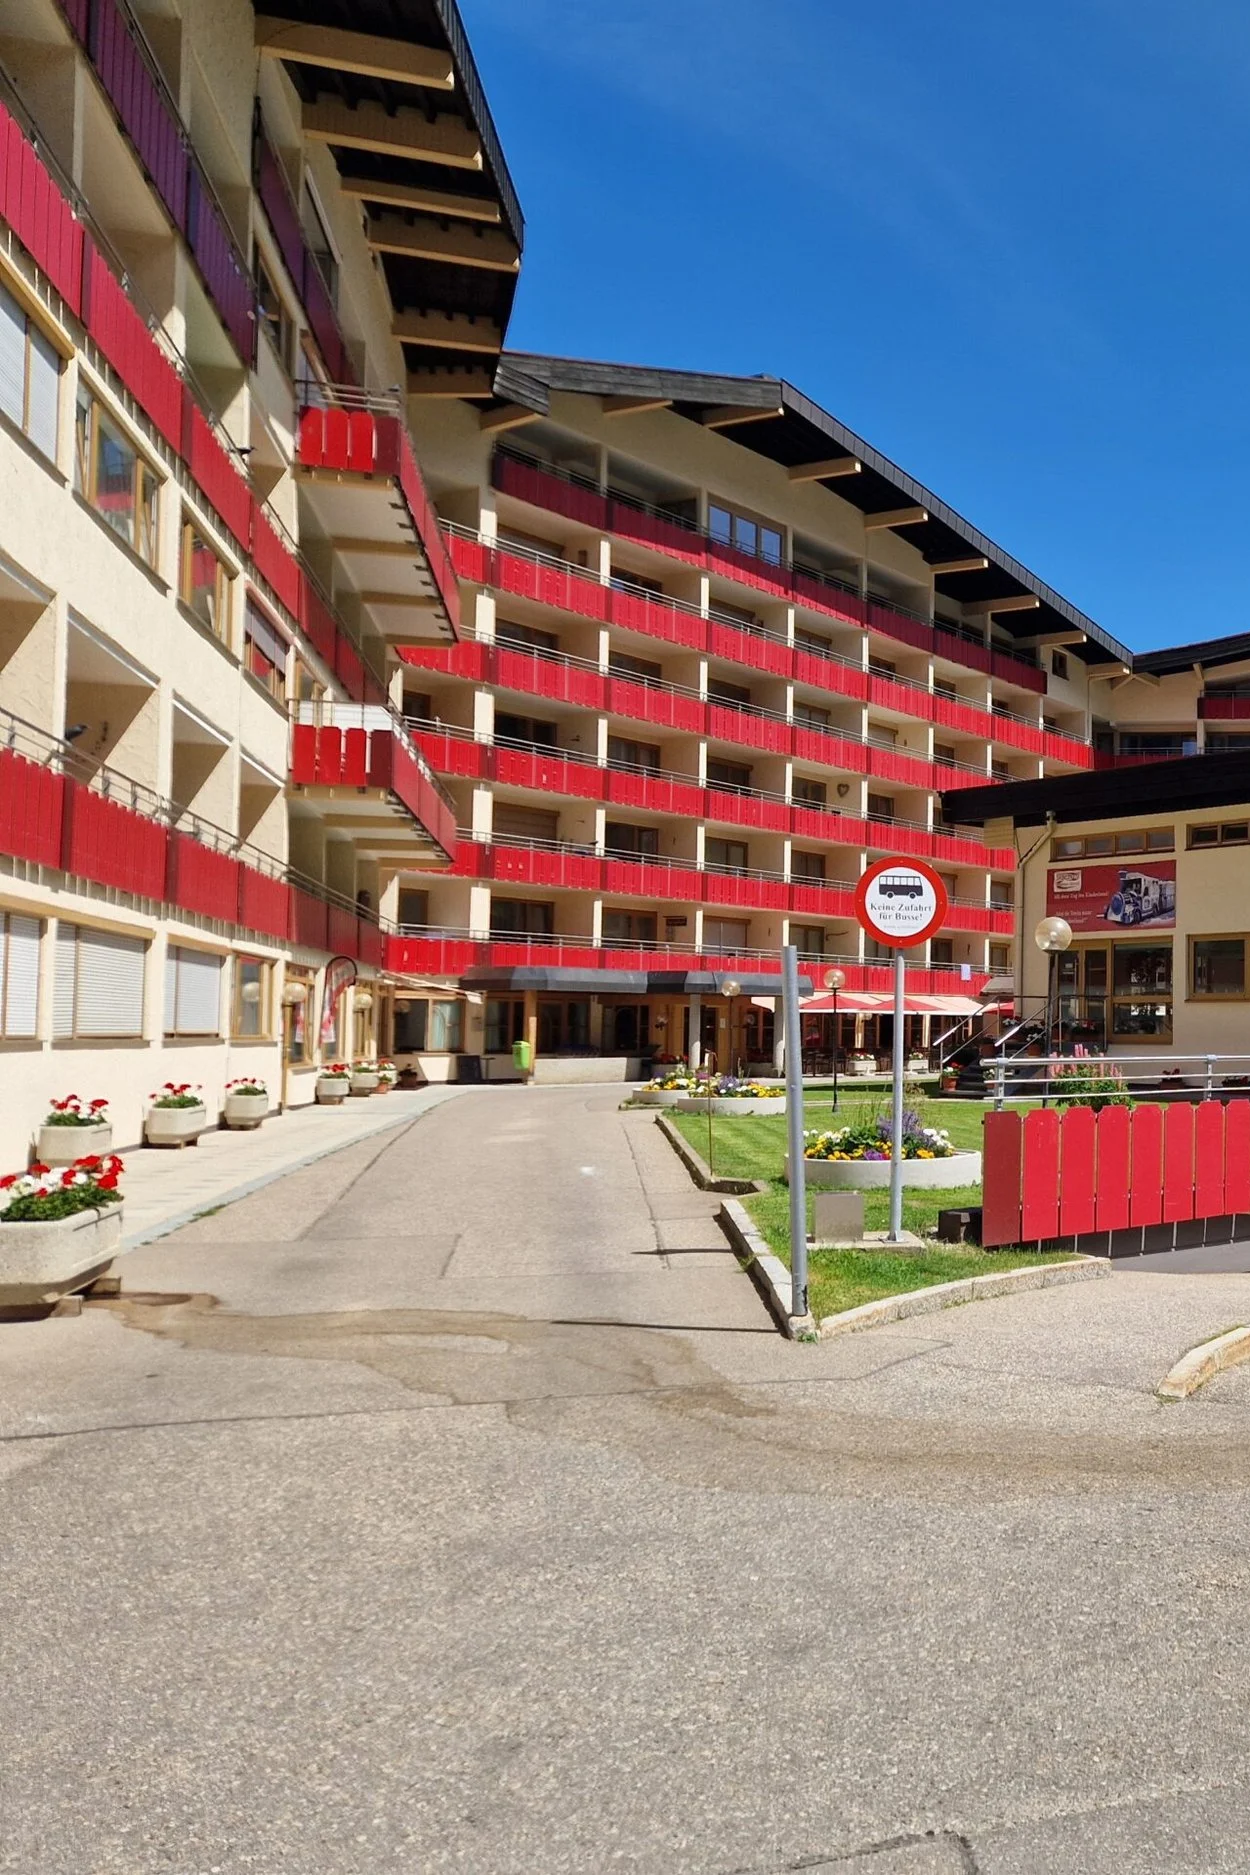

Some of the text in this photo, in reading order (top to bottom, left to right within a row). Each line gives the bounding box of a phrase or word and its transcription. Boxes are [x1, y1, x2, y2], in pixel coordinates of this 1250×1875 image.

[870, 902, 932, 912] Keine Zufahrt
[879, 912, 923, 921] für Busse!
